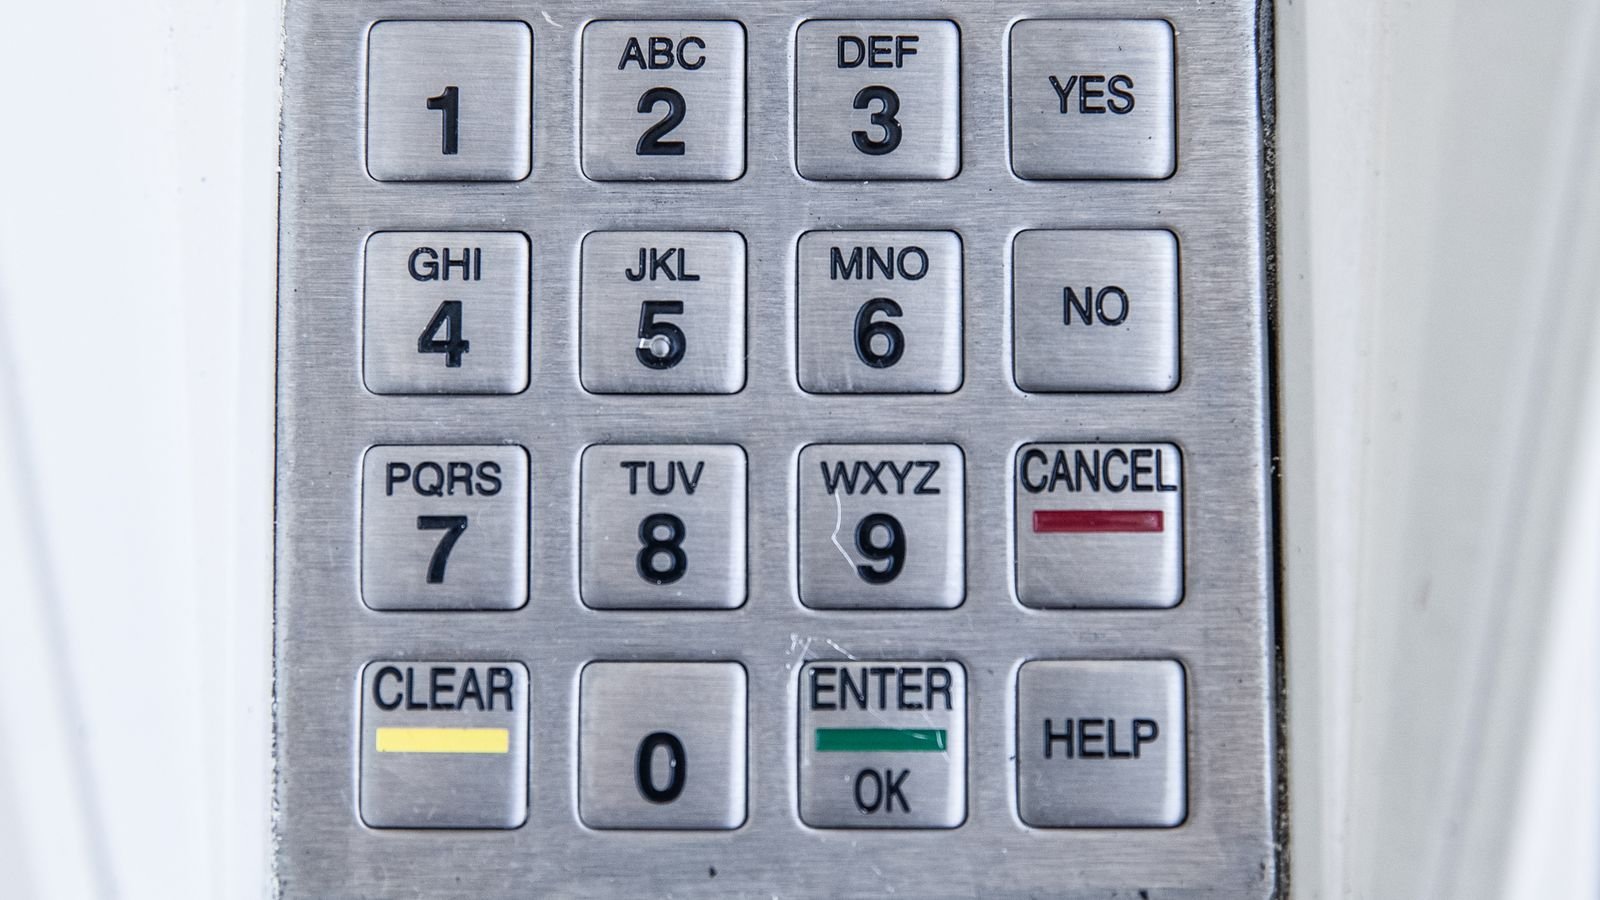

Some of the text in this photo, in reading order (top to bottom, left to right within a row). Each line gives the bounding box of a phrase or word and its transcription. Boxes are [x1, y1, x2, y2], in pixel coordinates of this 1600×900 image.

[618, 37, 705, 70] ABC
[838, 36, 919, 68] DEF
[1049, 75, 1134, 114] YES
[427, 87, 458, 154] 1
[636, 87, 686, 155] 2
[852, 86, 902, 155] 3
[409, 247, 481, 281] GHI
[626, 248, 700, 281] JKL
[831, 246, 928, 280] MNO
[1064, 286, 1128, 326] NO
[418, 301, 469, 367] 4
[636, 301, 686, 370] 5
[854, 298, 904, 368] 6
[387, 461, 501, 497] PQRS
[621, 462, 704, 495] TUV
[821, 461, 940, 494] WXYZ
[1021, 449, 1177, 493] CANCEL
[418, 516, 467, 583] 7
[637, 513, 687, 585] 8
[855, 513, 906, 585] 9
[374, 666, 513, 710] CLEAR
[811, 667, 952, 710] ENTER
[1044, 719, 1158, 759] HELP
[637, 732, 686, 804] 0
[854, 768, 910, 814] OK
